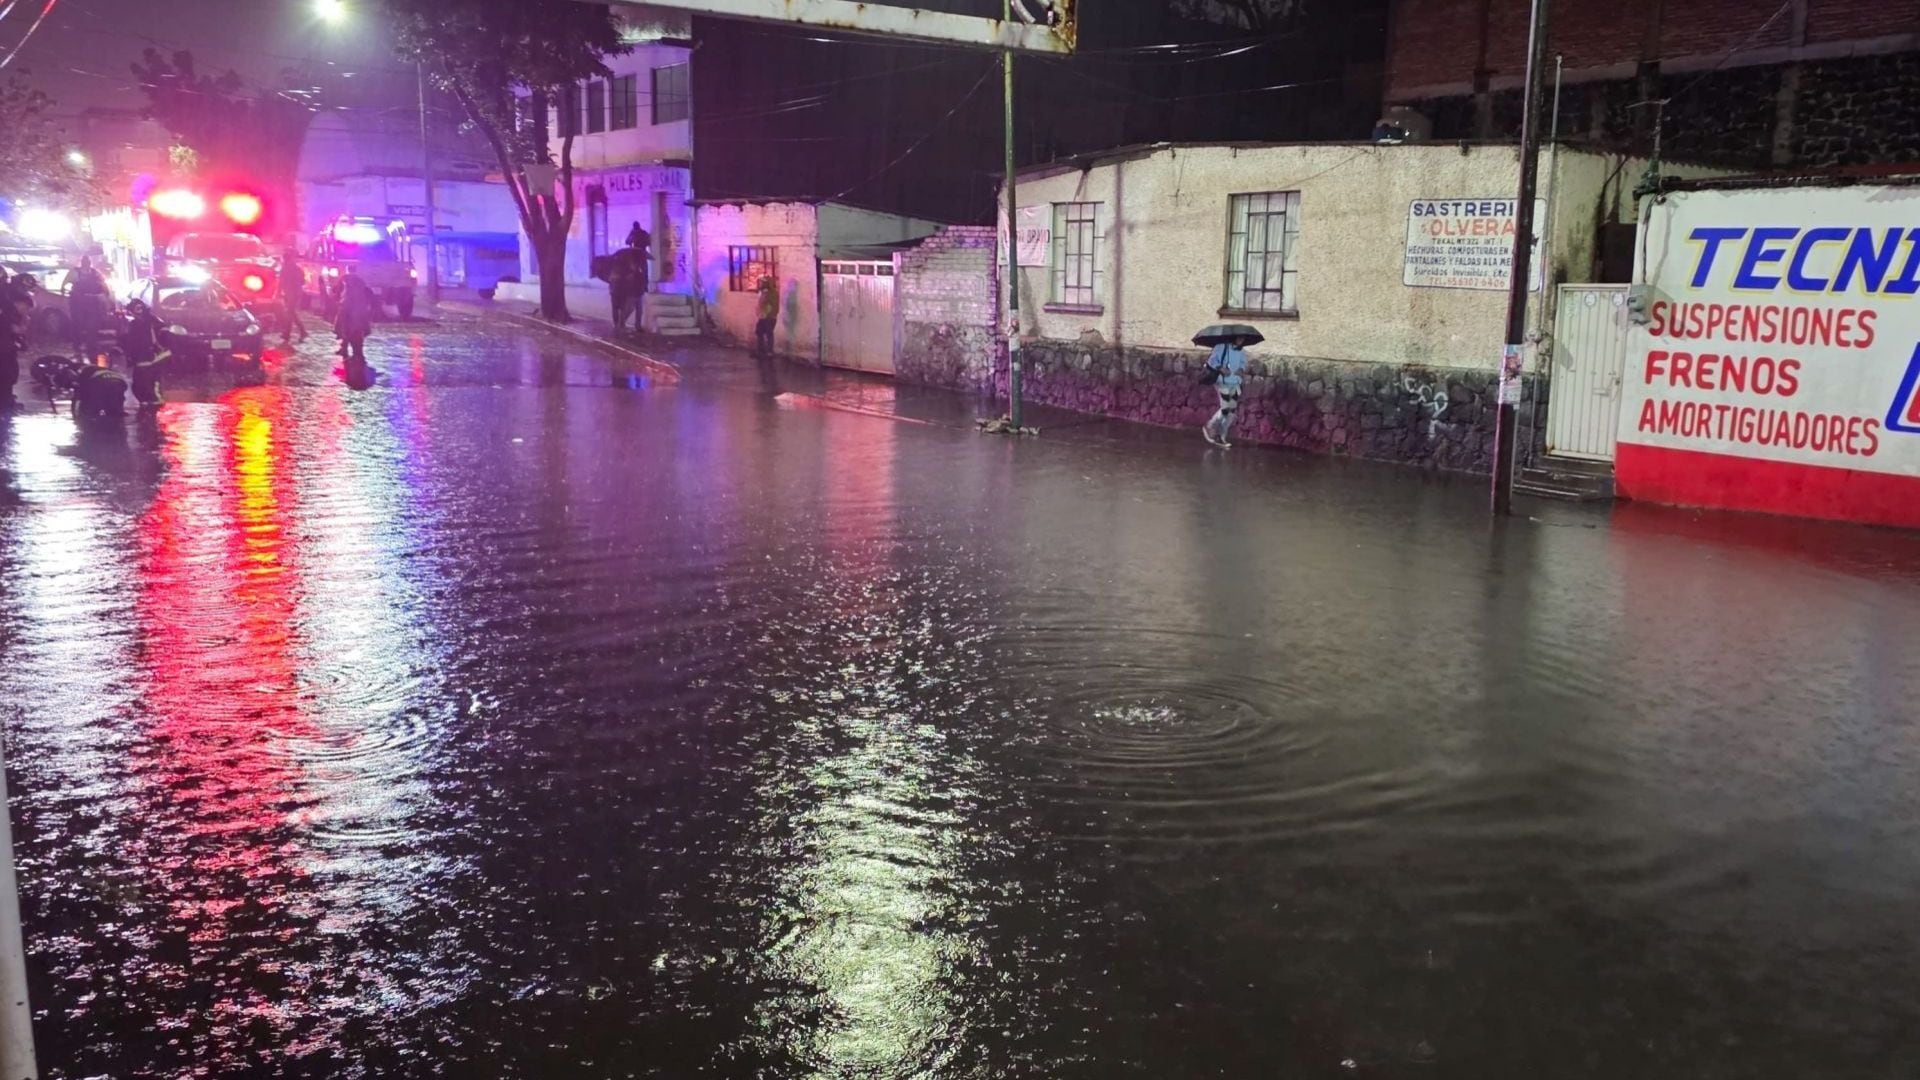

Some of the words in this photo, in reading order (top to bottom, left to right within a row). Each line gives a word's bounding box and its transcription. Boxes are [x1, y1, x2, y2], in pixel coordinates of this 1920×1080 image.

[1413, 202, 1514, 217] SASTRERI
[1430, 218, 1516, 237] OLVERA
[1499, 257, 1514, 267] ME
[1687, 226, 1920, 297] TECNI
[1648, 300, 1878, 349] SUSPENSIONES
[1644, 350, 1801, 397] FRENOS
[1638, 398, 1881, 457] AMORTIGUADORES
